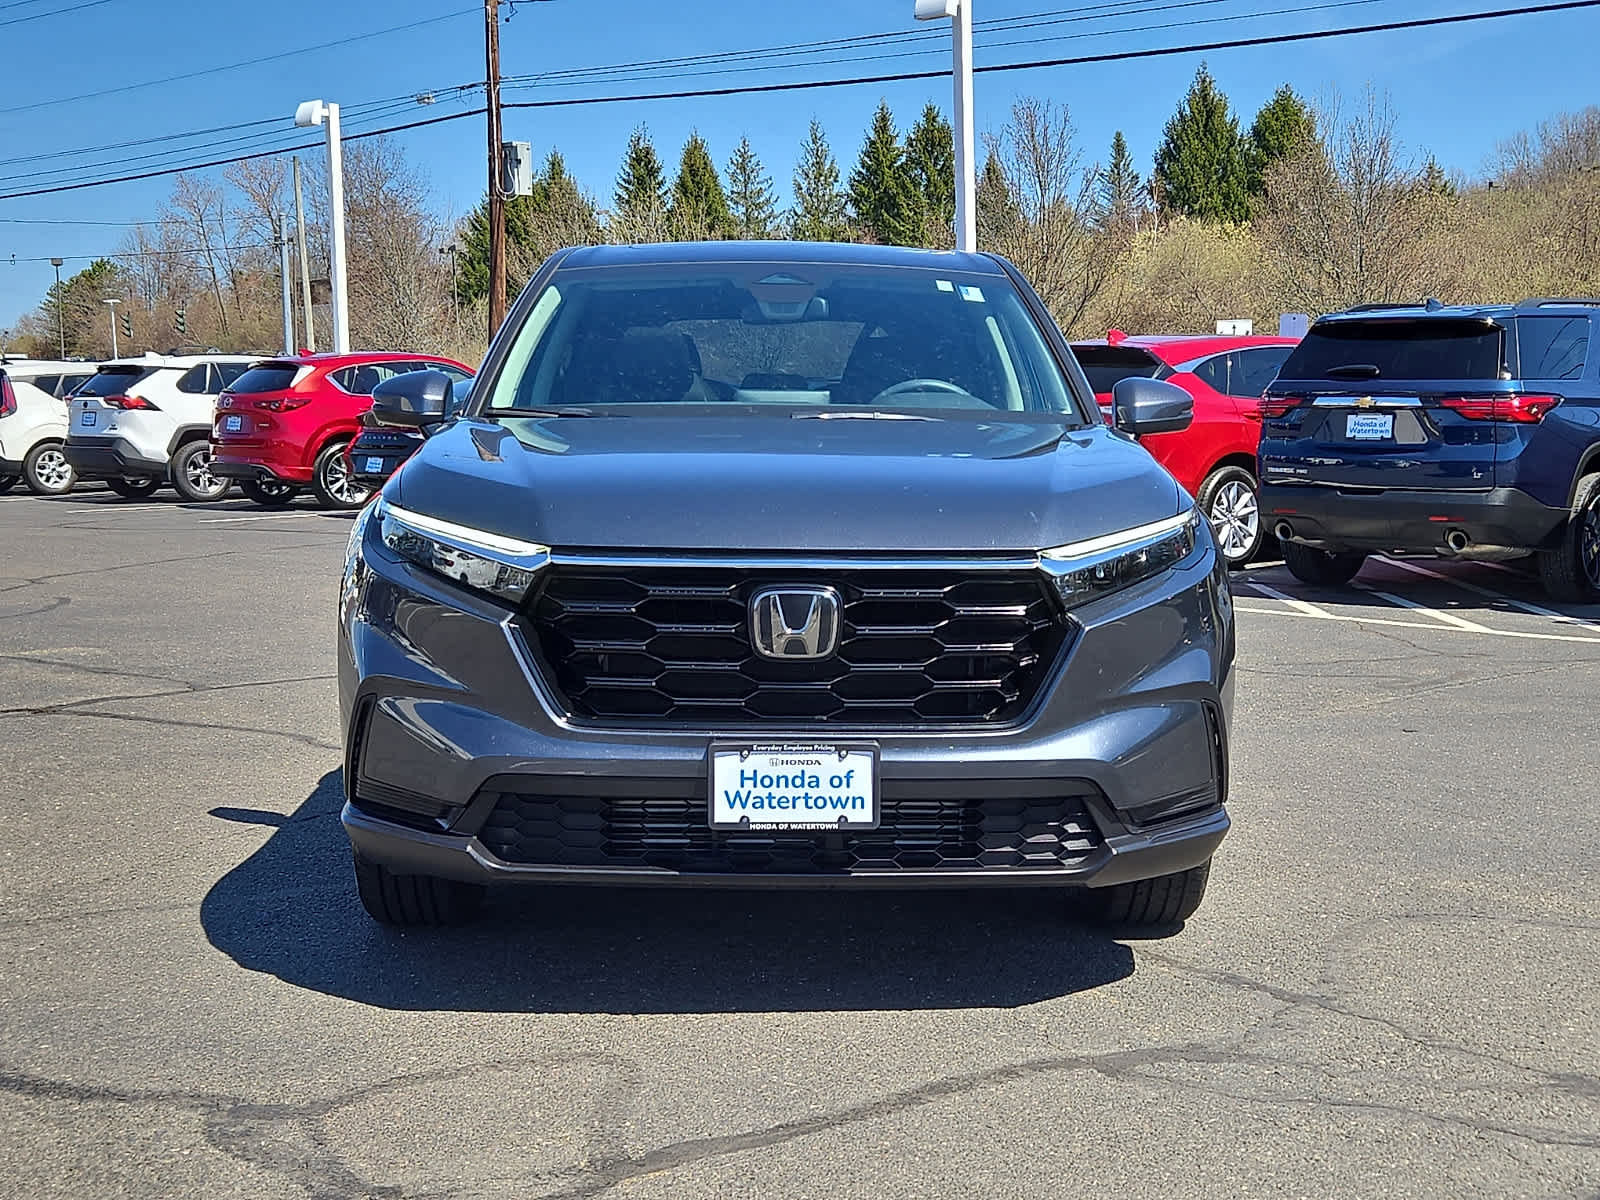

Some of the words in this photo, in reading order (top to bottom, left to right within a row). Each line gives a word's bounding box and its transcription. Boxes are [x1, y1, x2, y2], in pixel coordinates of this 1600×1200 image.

[752, 744, 782, 752] Everyday
[783, 744, 813, 752] Employee
[814, 744, 836, 752] Pricing
[740, 769, 820, 788] Honda
[829, 769, 855, 788] of
[724, 790, 865, 810] Watertown
